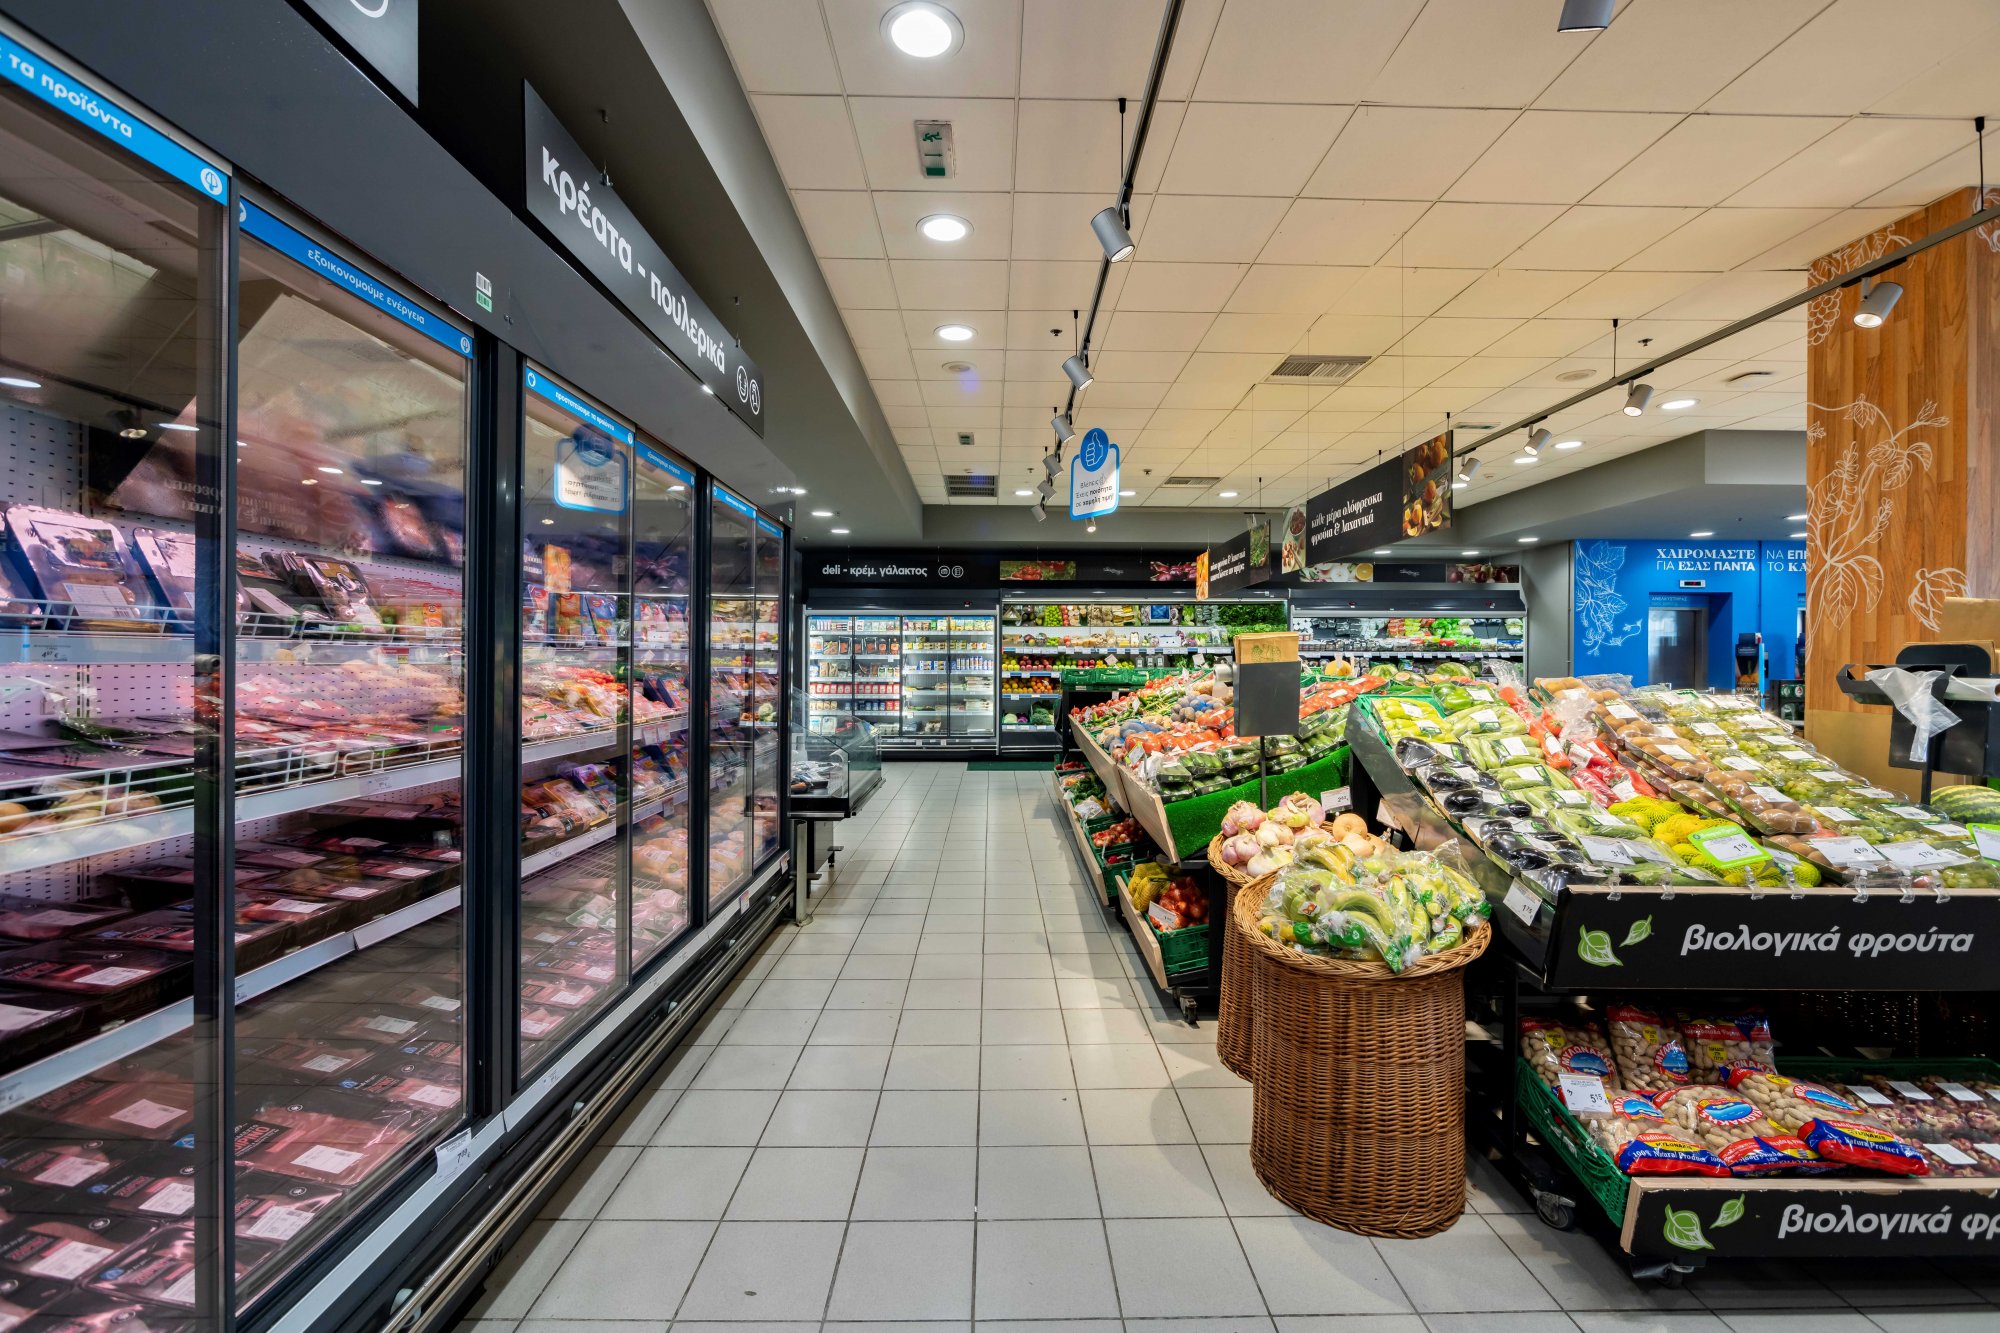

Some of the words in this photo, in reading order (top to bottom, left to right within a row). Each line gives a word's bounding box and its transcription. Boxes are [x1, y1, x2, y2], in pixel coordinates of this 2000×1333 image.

[9, 53, 34, 79] τα
[41, 73, 132, 138] προϊόντα
[542, 146, 632, 275] κρέατα
[650, 270, 725, 374] πουλερικά
[308, 249, 384, 301] εξοικονομούμε
[386, 297, 425, 325] ενέργεια
[1326, 507, 1342, 526] μέρα
[1334, 522, 1341, 536] &
[1340, 508, 1374, 534] λαχανικά
[1656, 548, 1756, 560] ΧΑΙΡΟΜΑΣΤΕ
[1766, 549, 1784, 560] ΝΑ
[822, 564, 841, 575] deli
[850, 564, 877, 577] κρέμ.
[879, 565, 928, 577] γάλακτος
[1656, 560, 1675, 571] ΓΙΑ
[1678, 560, 1710, 571] ΕΣΑΣ
[1714, 561, 1756, 572] ΠΑΝΤΑ
[1767, 561, 1784, 572] ΤΟ
[1680, 924, 1841, 957] βιολογικά
[1848, 926, 1975, 957] φρούτα
[1777, 1203, 1953, 1240] βιολογικά
